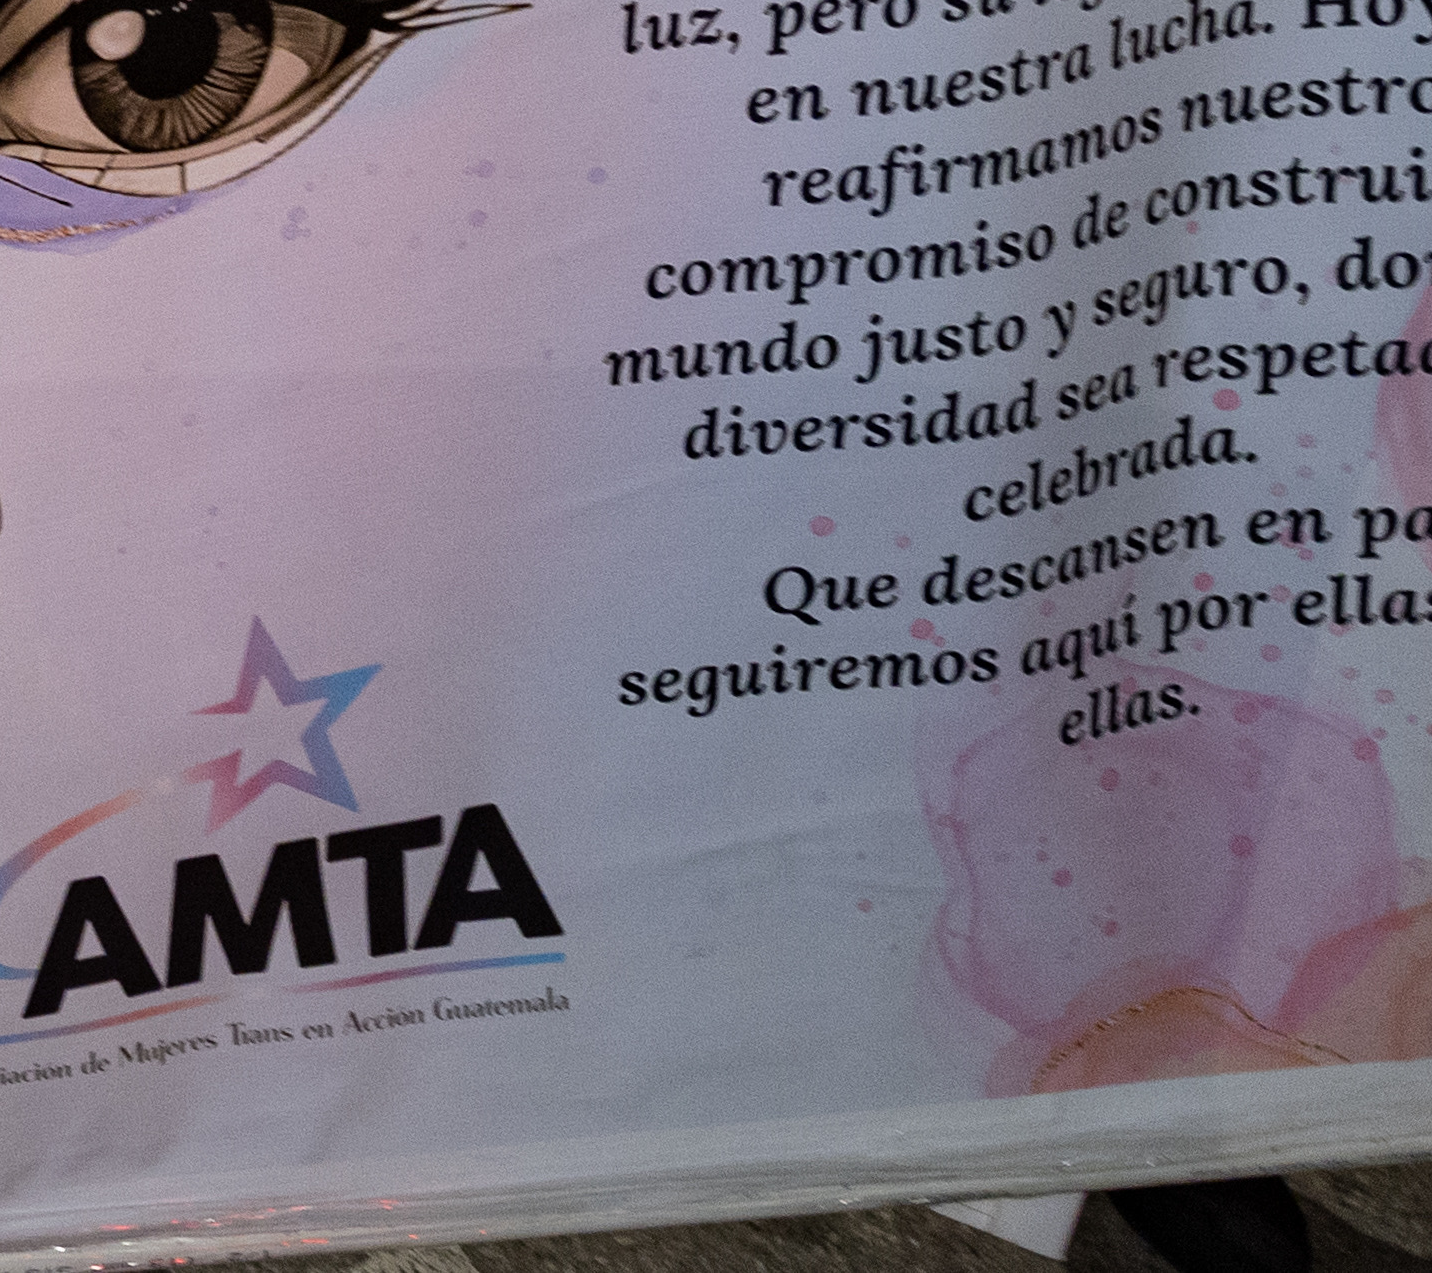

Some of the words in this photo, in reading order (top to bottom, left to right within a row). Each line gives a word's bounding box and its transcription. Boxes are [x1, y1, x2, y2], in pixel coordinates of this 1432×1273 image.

[621, 1, 740, 55] luz,
[746, 84, 829, 125] en
[850, 43, 1093, 117] nuestra
[763, 106, 1164, 216] reafirmamos
[645, 219, 1055, 306] compromiso
[1072, 192, 1129, 250] de
[604, 320, 840, 387] mundo
[854, 312, 1027, 385] justo
[1046, 300, 1076, 359] y
[1092, 256, 1310, 327] seguro,
[1335, 235, 1432, 292] do
[683, 382, 1040, 460] diversidad
[1056, 364, 1137, 421] sea
[963, 415, 1258, 522] celebrada.
[763, 565, 898, 627] Que
[922, 512, 1224, 608] descansen
[1246, 507, 1332, 546] en
[618, 644, 1000, 718] seguiremos
[1020, 593, 1139, 681] aquí
[1158, 592, 1270, 655] por
[1292, 573, 1432, 627] ella
[1058, 683, 1201, 747] ellas.
[21, 803, 565, 1020] AMTA
[81, 1051, 110, 1074] de
[118, 1036, 218, 1066] Mujeres
[225, 1021, 294, 1045] Trans
[302, 1023, 334, 1040] en
[432, 986, 570, 1021] Guatemala
